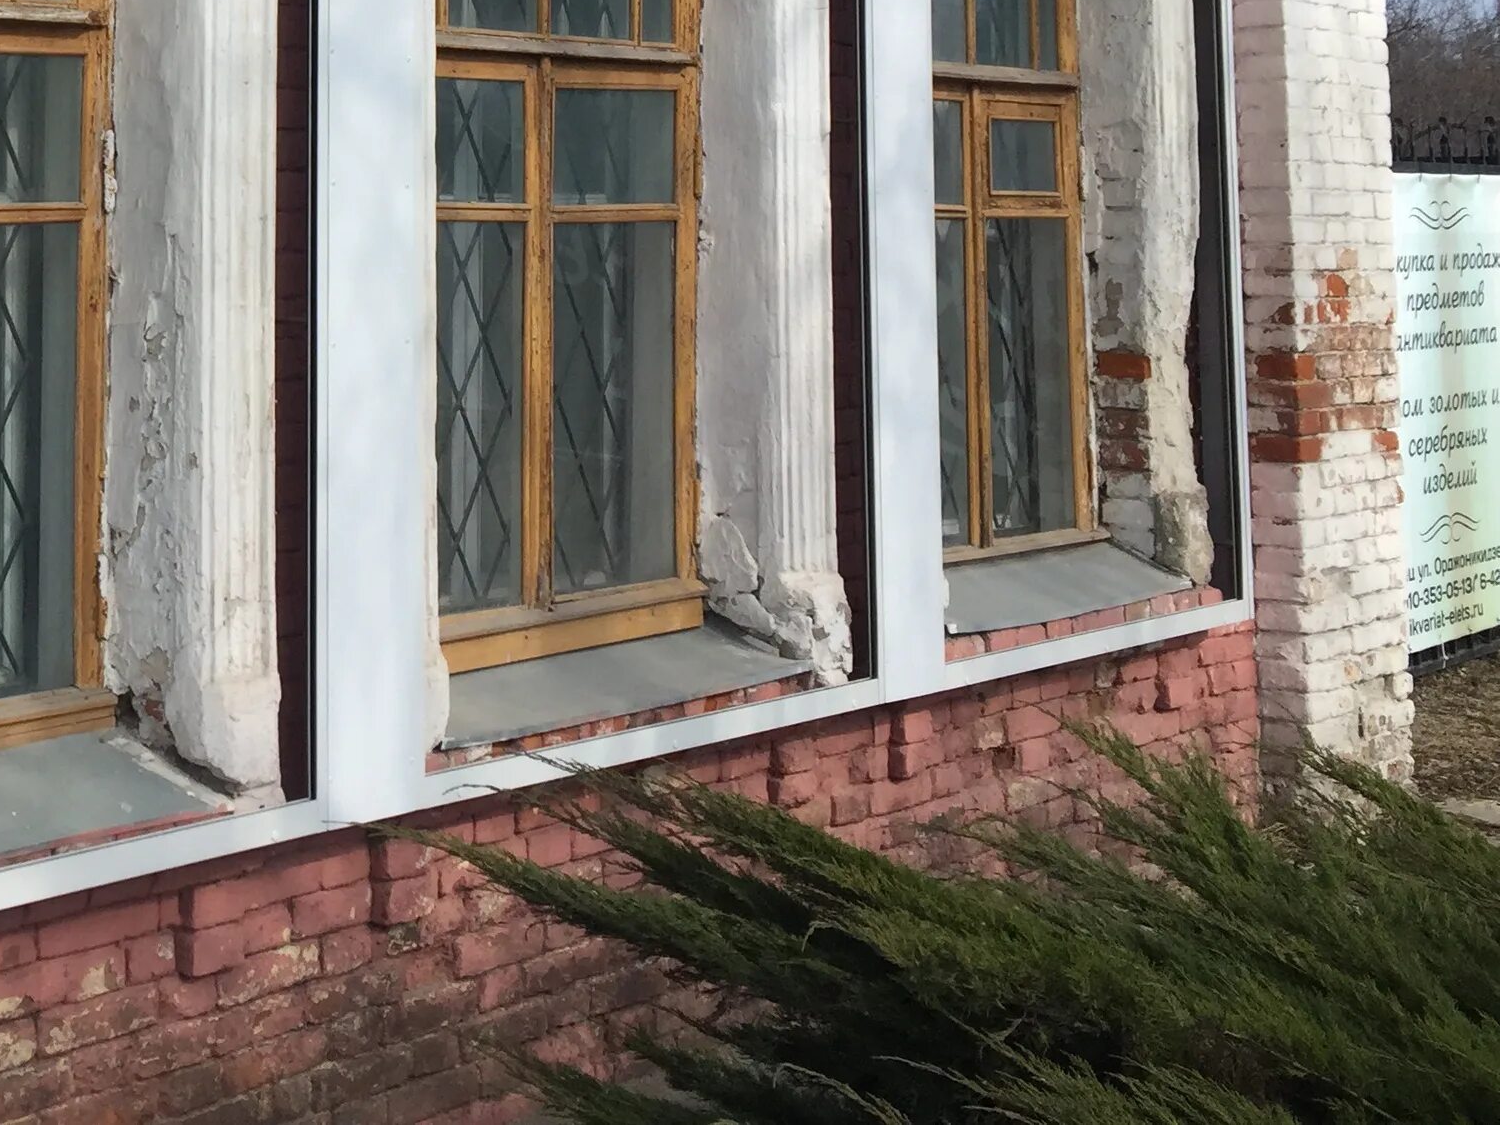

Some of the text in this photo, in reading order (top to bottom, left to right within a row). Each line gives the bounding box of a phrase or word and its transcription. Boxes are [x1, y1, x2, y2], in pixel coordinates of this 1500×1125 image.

[1396, 253, 1435, 280] купка
[1453, 243, 1500, 277] продаж
[1406, 280, 1485, 319] предметов
[1402, 398, 1424, 418] ом
[1429, 390, 1488, 414] золотых
[1408, 424, 1488, 463] серебряных
[1423, 460, 1478, 494] изделий
[1480, 569, 1500, 590] 6-42
[1409, 603, 1484, 636] ikvariat-elets.ru
